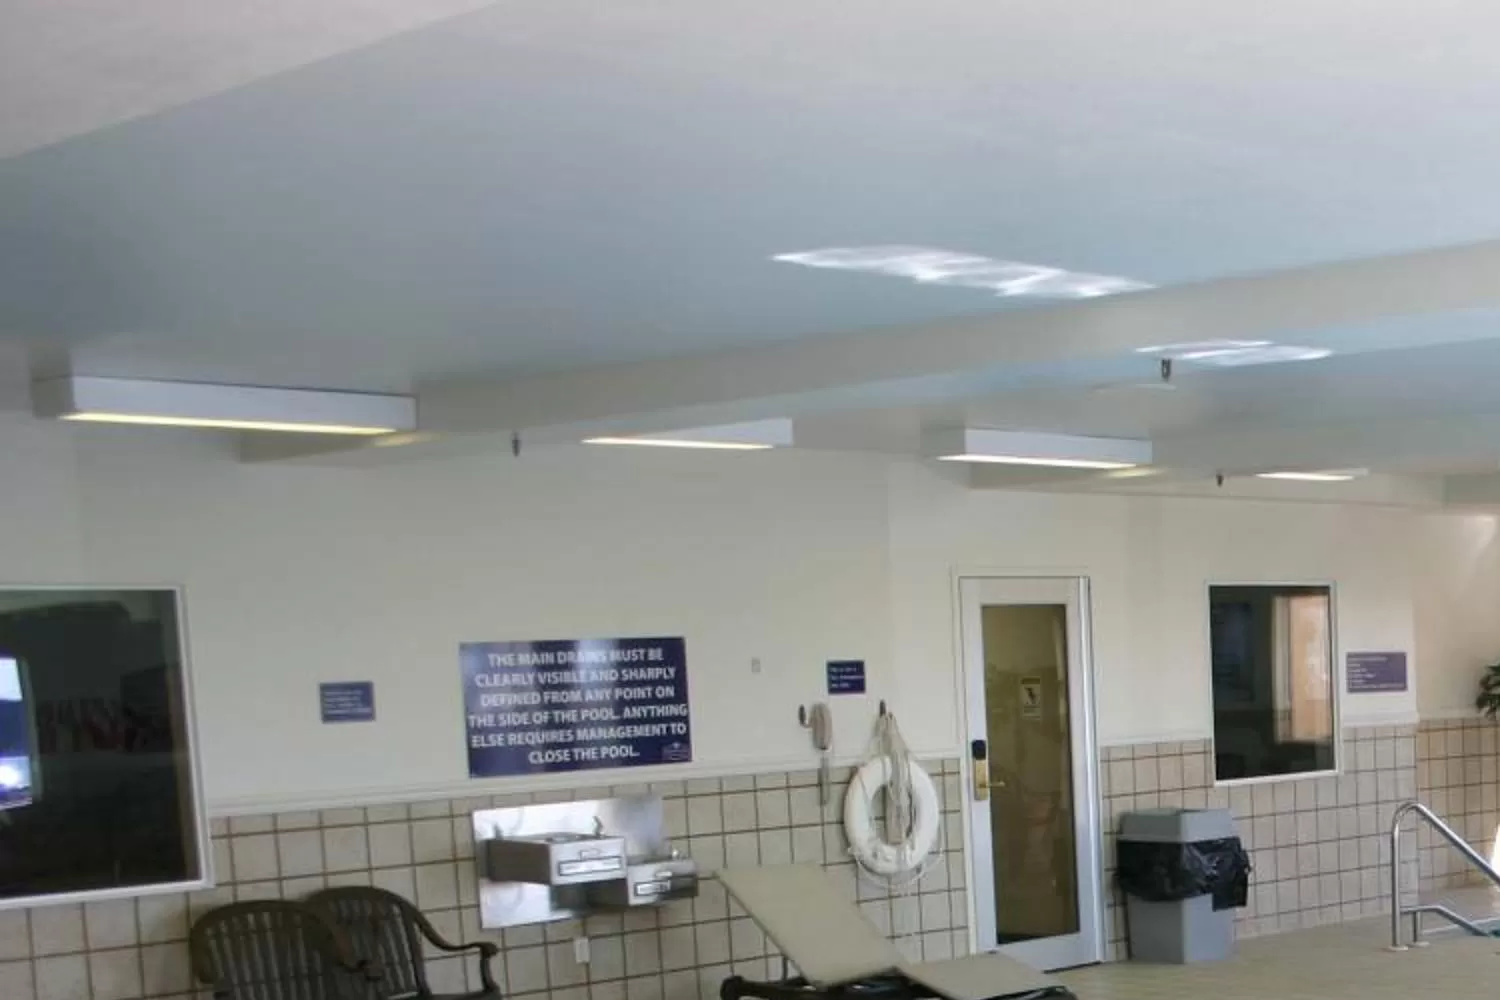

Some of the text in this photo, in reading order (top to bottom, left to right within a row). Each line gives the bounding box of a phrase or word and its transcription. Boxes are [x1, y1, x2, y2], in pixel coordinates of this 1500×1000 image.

[487, 647, 664, 668] THE MAIN DRAS MUST BE
[475, 666, 676, 689] CLEARLY VISIBLE AND SHARPLY
[481, 684, 675, 707] DEFINED FROM ANY POINT ON
[468, 713, 497, 729] THE
[498, 711, 532, 728] SIDE
[533, 709, 550, 725] OF
[552, 708, 580, 724] THE
[623, 702, 688, 719] ANYTHING
[471, 721, 687, 749] ELSE REQUIRES MANAGEMENT TO
[528, 747, 572, 765] CLOSE
[572, 745, 599, 762] THE
[601, 743, 641, 759] POOL.
